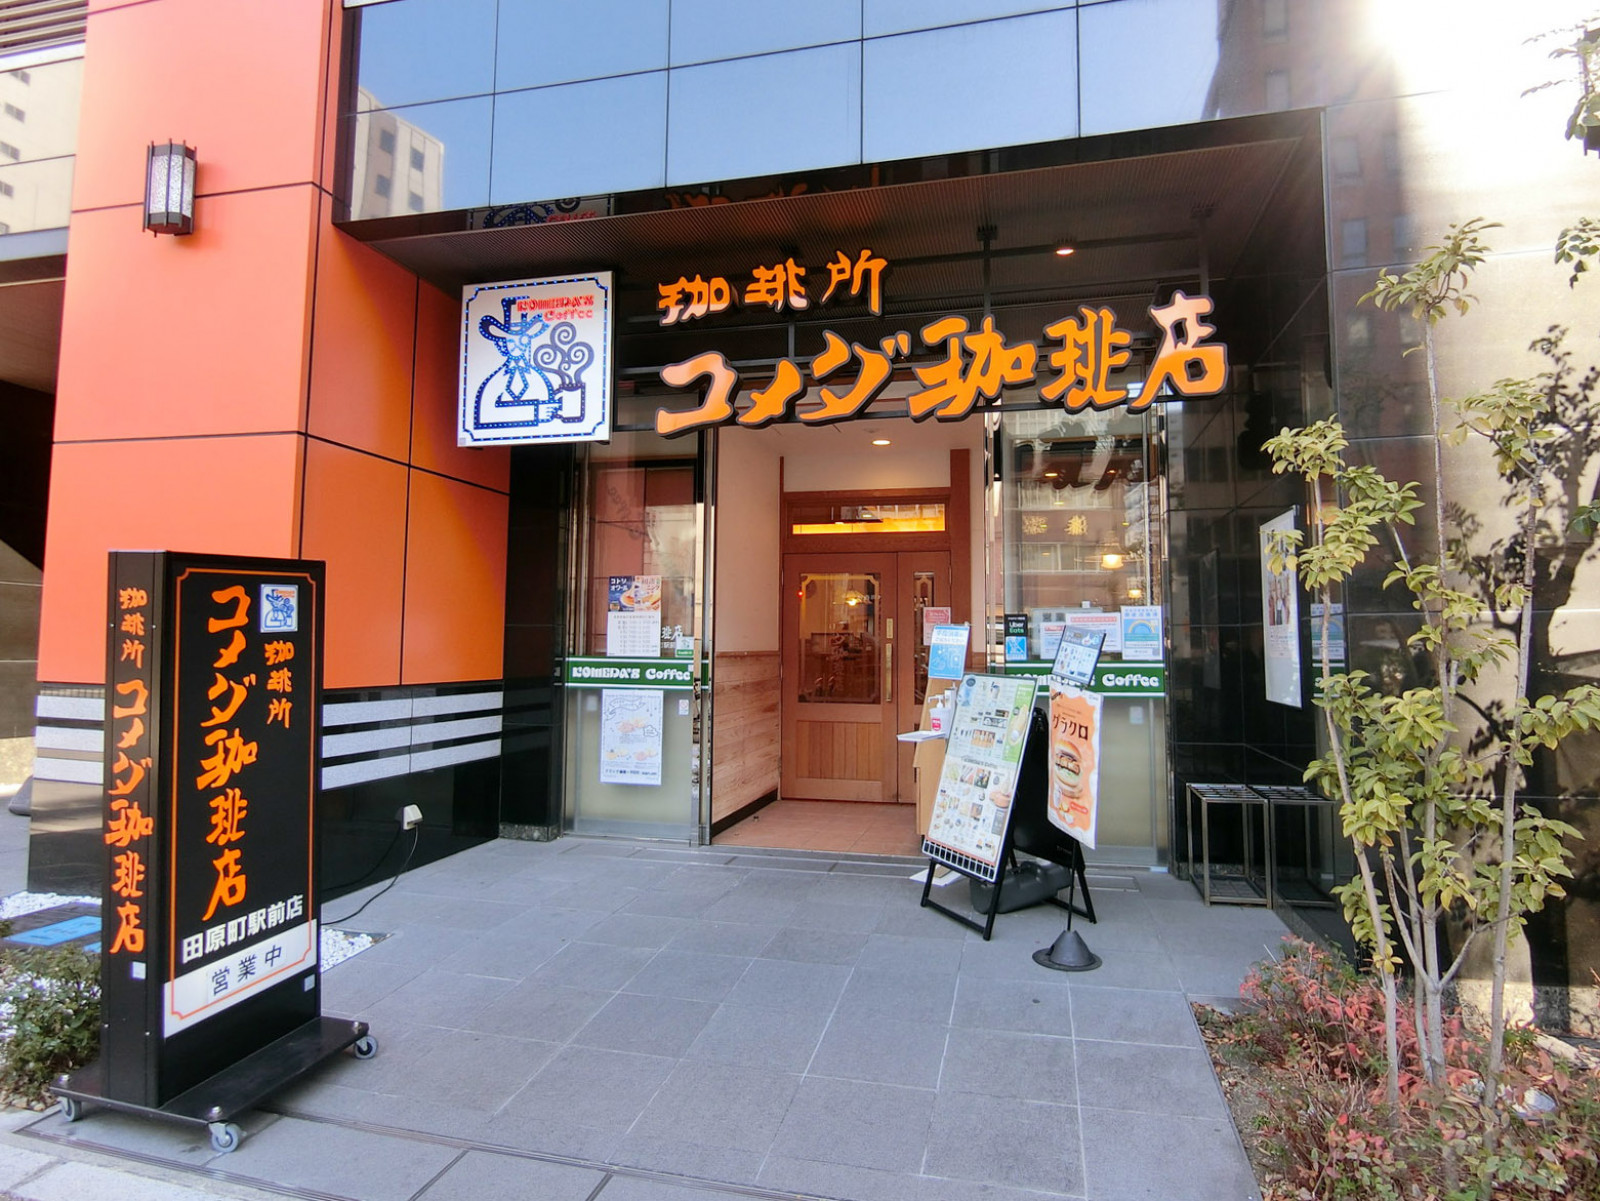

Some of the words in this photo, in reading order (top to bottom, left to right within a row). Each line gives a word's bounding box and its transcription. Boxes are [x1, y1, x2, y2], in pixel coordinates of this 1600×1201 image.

[572, 666, 641, 679] KOMEDA'S
[645, 668, 691, 680] Coffee
[1101, 673, 1160, 687] Coffee
[1052, 713, 1089, 741] グラクロ
[182, 894, 304, 965] 田原町駅前店
[211, 944, 283, 997] 営業中
